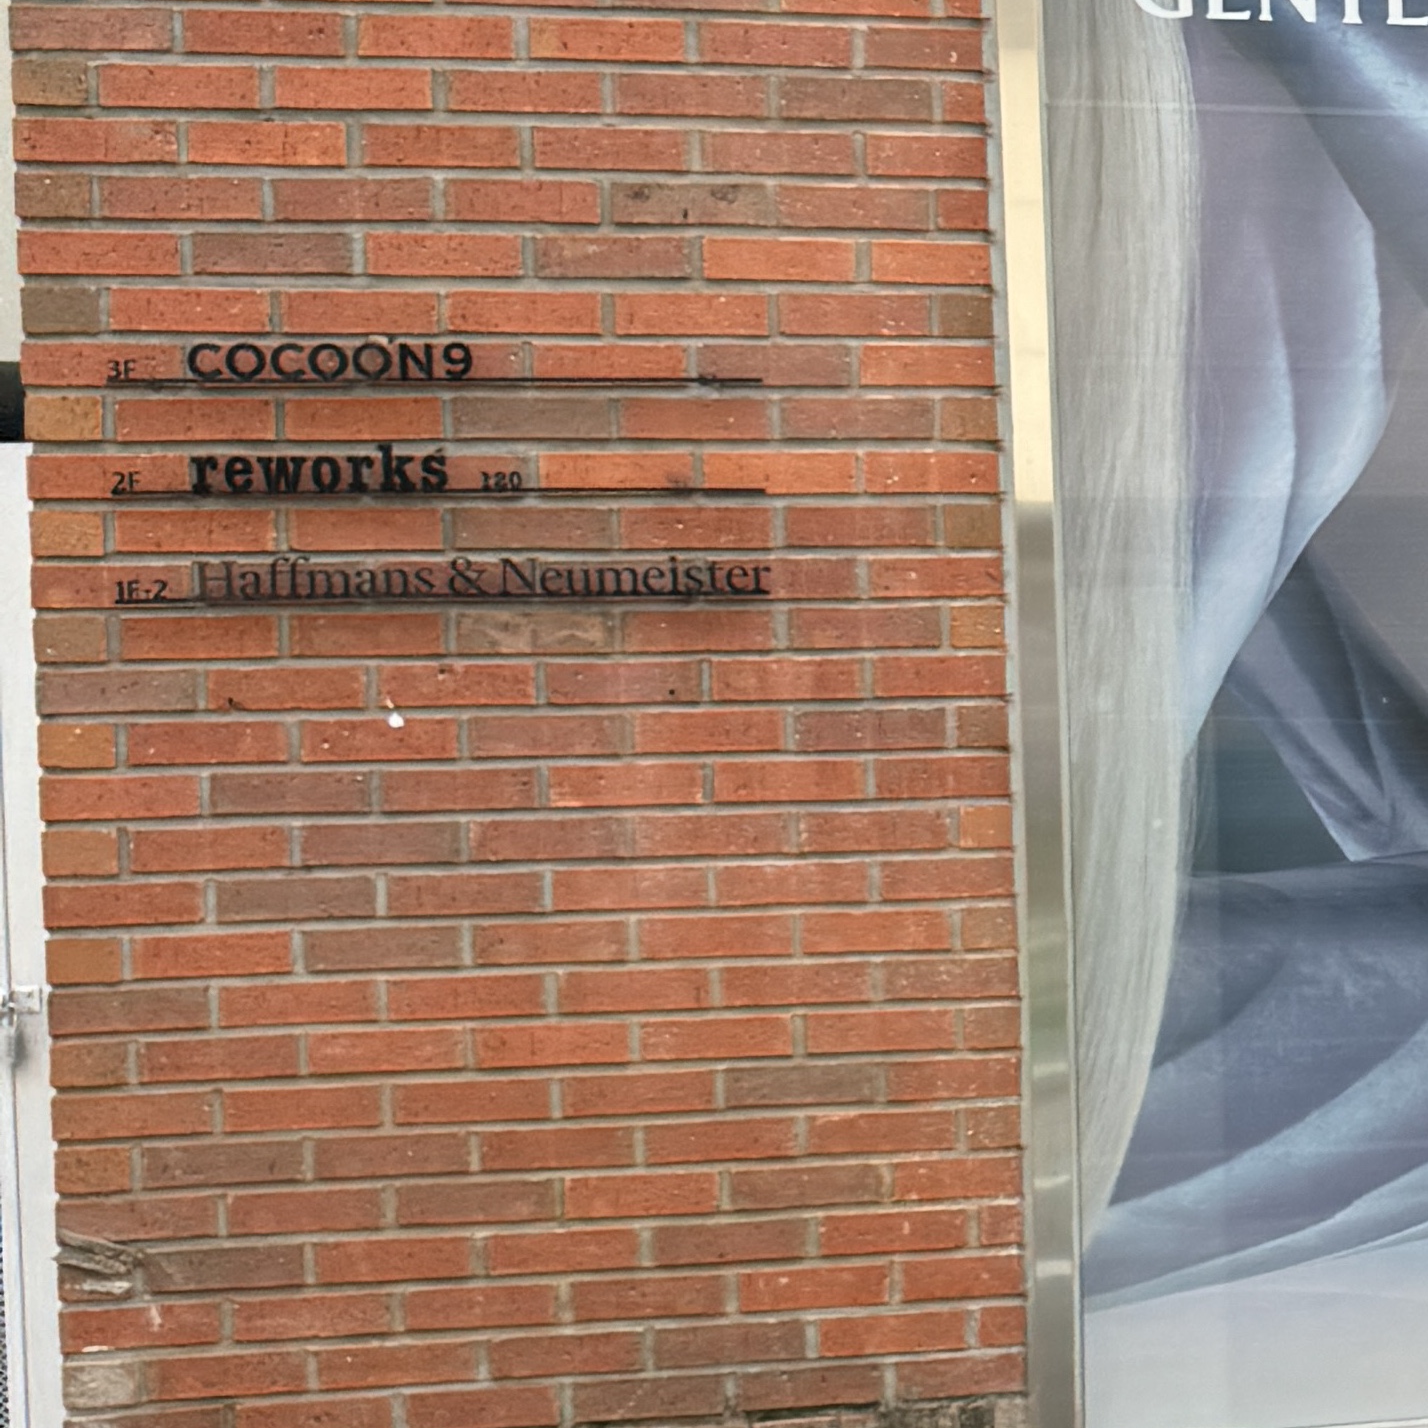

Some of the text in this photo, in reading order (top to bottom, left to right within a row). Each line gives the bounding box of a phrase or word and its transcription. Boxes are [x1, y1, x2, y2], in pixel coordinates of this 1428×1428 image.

[107, 341, 474, 381] 3F COCOON9
[110, 470, 141, 494] 2F
[190, 444, 448, 494] reworks
[194, 556, 433, 598] Haffmans
[448, 557, 487, 598] &
[499, 556, 772, 598] Neumeister
